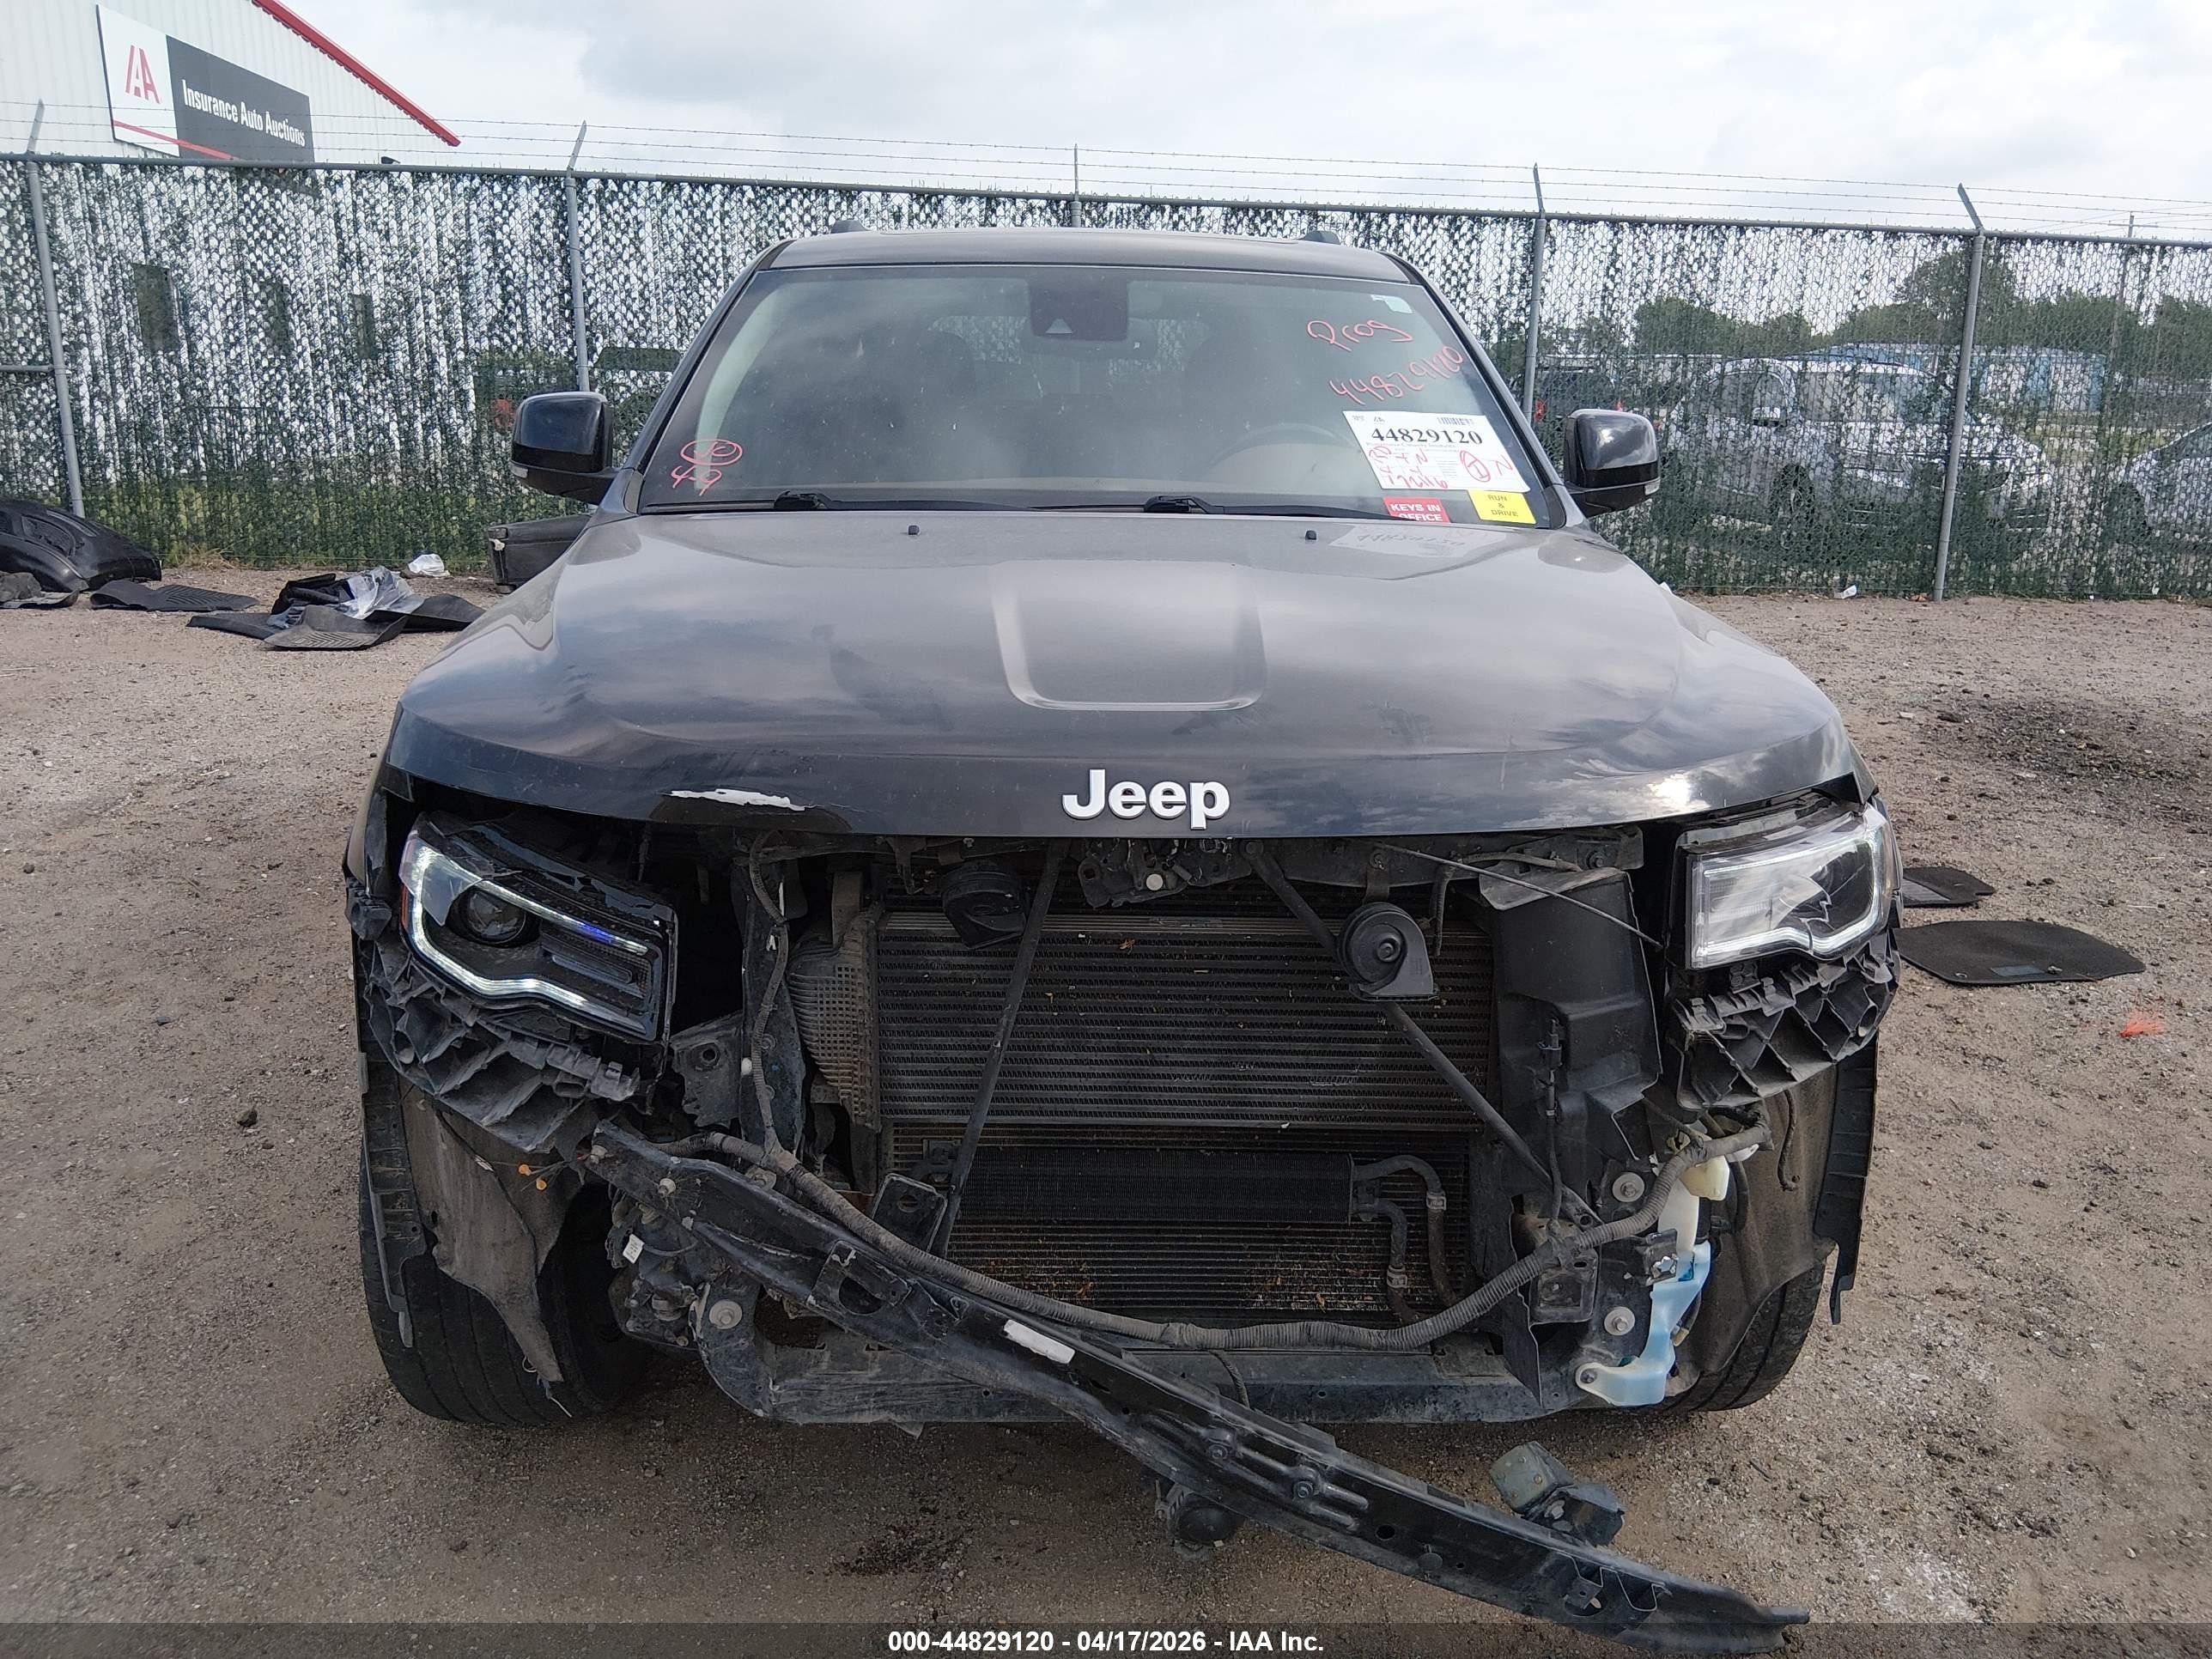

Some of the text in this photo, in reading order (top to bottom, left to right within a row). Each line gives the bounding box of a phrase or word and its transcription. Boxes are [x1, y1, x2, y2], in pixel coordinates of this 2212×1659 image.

[182, 79, 306, 148] Insurance Auto Auctions
[1371, 428, 1483, 444] 44829120
[1389, 503, 1425, 512] KEYS
[1062, 769, 1231, 830] Jeep
